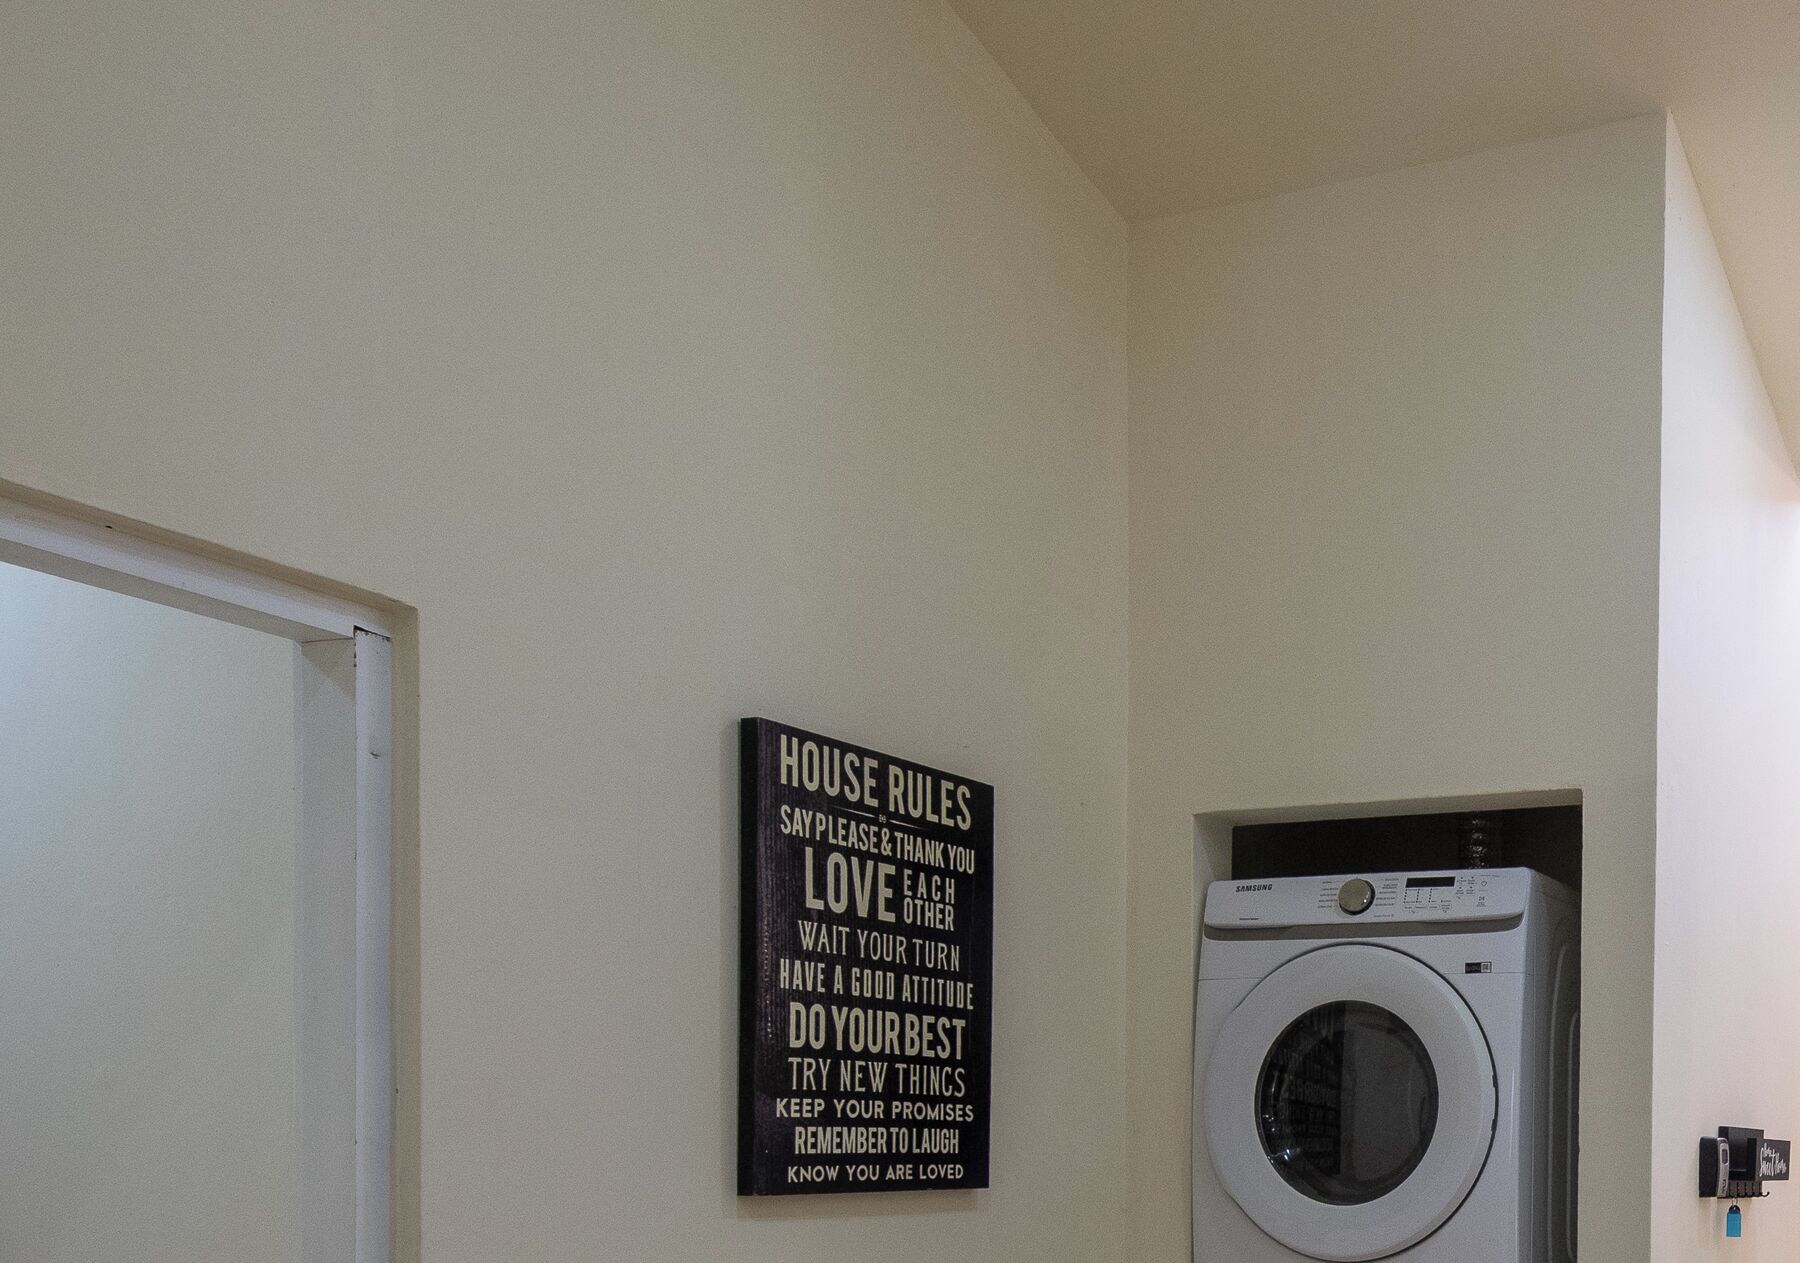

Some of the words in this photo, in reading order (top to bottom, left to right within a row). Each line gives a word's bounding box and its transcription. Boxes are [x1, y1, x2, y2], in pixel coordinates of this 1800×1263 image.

[780, 734, 878, 807] HOUSE
[889, 764, 971, 830] RULES
[780, 805, 817, 838] SAY
[816, 813, 878, 854] PLEASE
[881, 828, 892, 856] &
[894, 832, 945, 868] THANK
[948, 844, 974, 874] YOU
[805, 846, 896, 922] LOVE
[904, 869, 954, 903] EACH
[1236, 883, 1273, 893] SAMSUNG
[903, 898, 954, 931] OTHER
[798, 920, 849, 955] WAIT
[857, 929, 907, 964] YOUR
[913, 939, 960, 972] TURN
[780, 959, 825, 992] HAVE
[834, 965, 843, 995] A
[852, 967, 895, 1000] GOOD
[902, 974, 974, 1010] ATTITUDE
[789, 1002, 826, 1050] DO
[831, 1005, 900, 1055] YOUR
[905, 1013, 966, 1060] BEST
[788, 1057, 831, 1091] TRY
[840, 1059, 888, 1093] NEW
[895, 1063, 966, 1098] THINGS
[776, 1098, 825, 1118] KEEP
[833, 1100, 884, 1119] YOUR
[892, 1102, 974, 1122] PROMISES
[794, 1126, 887, 1154] REMEMBER
[890, 1127, 908, 1154] TO
[912, 1128, 959, 1154] LAUGH
[788, 1165, 839, 1183] KNOW
[846, 1164, 880, 1181] YOU
[885, 1164, 913, 1180] ARE
[919, 1164, 964, 1180] LOVED
